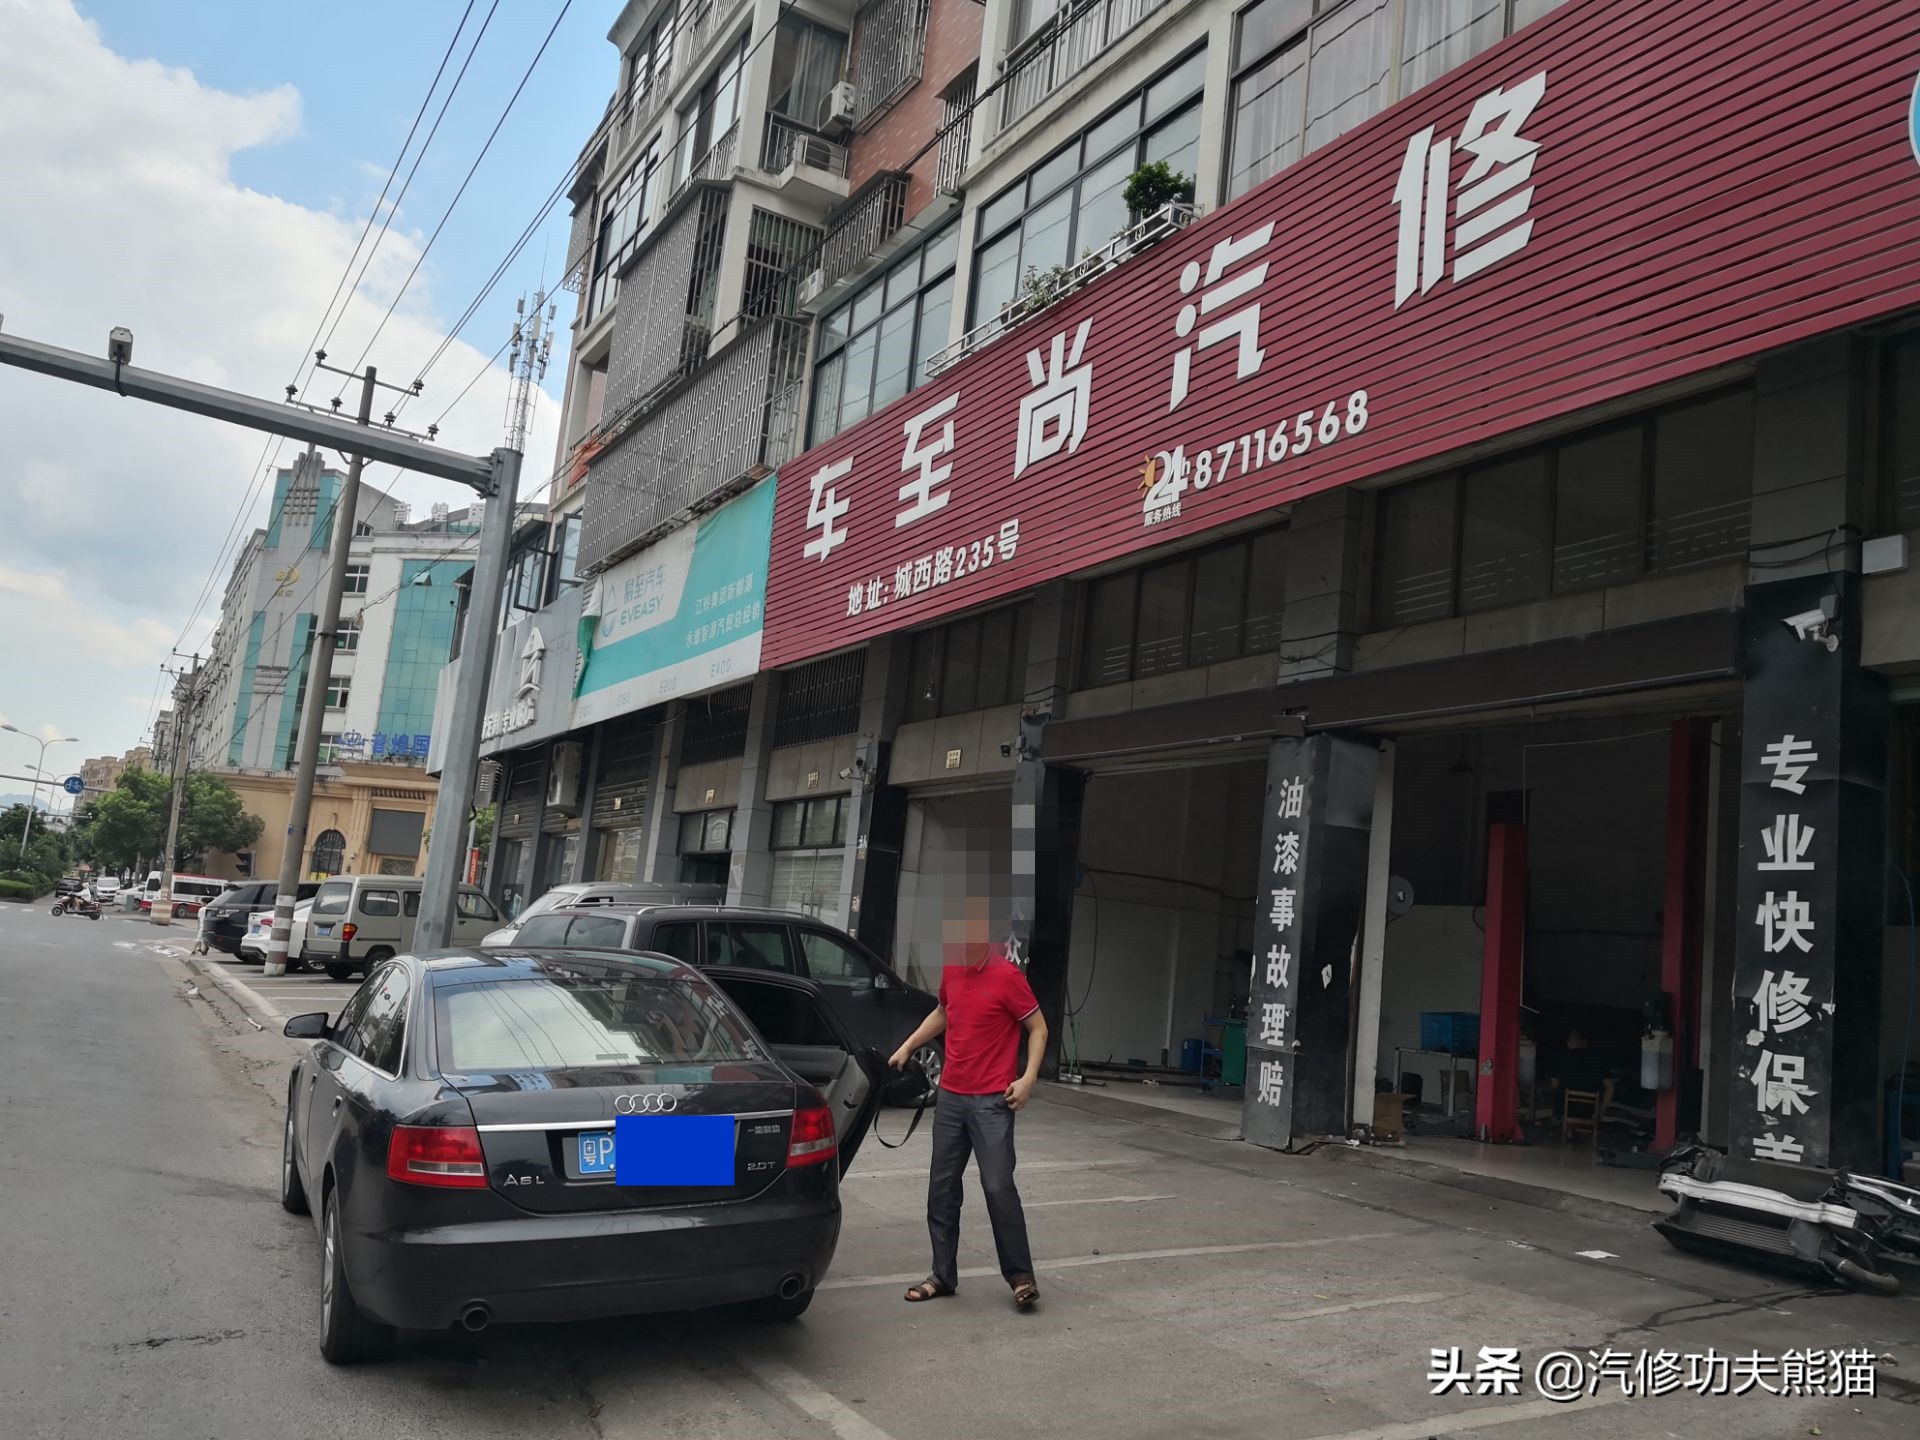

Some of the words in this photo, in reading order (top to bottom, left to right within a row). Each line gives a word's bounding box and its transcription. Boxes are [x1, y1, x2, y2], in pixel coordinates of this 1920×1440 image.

[803, 70, 1547, 563] 车至尚汽修
[1193, 390, 1369, 491] 87116568
[1143, 502, 1182, 527] 服务热线
[620, 594, 664, 625] EVEASY
[710, 659, 731, 678] E400
[1257, 776, 1304, 1107] 油漆事故理赔
